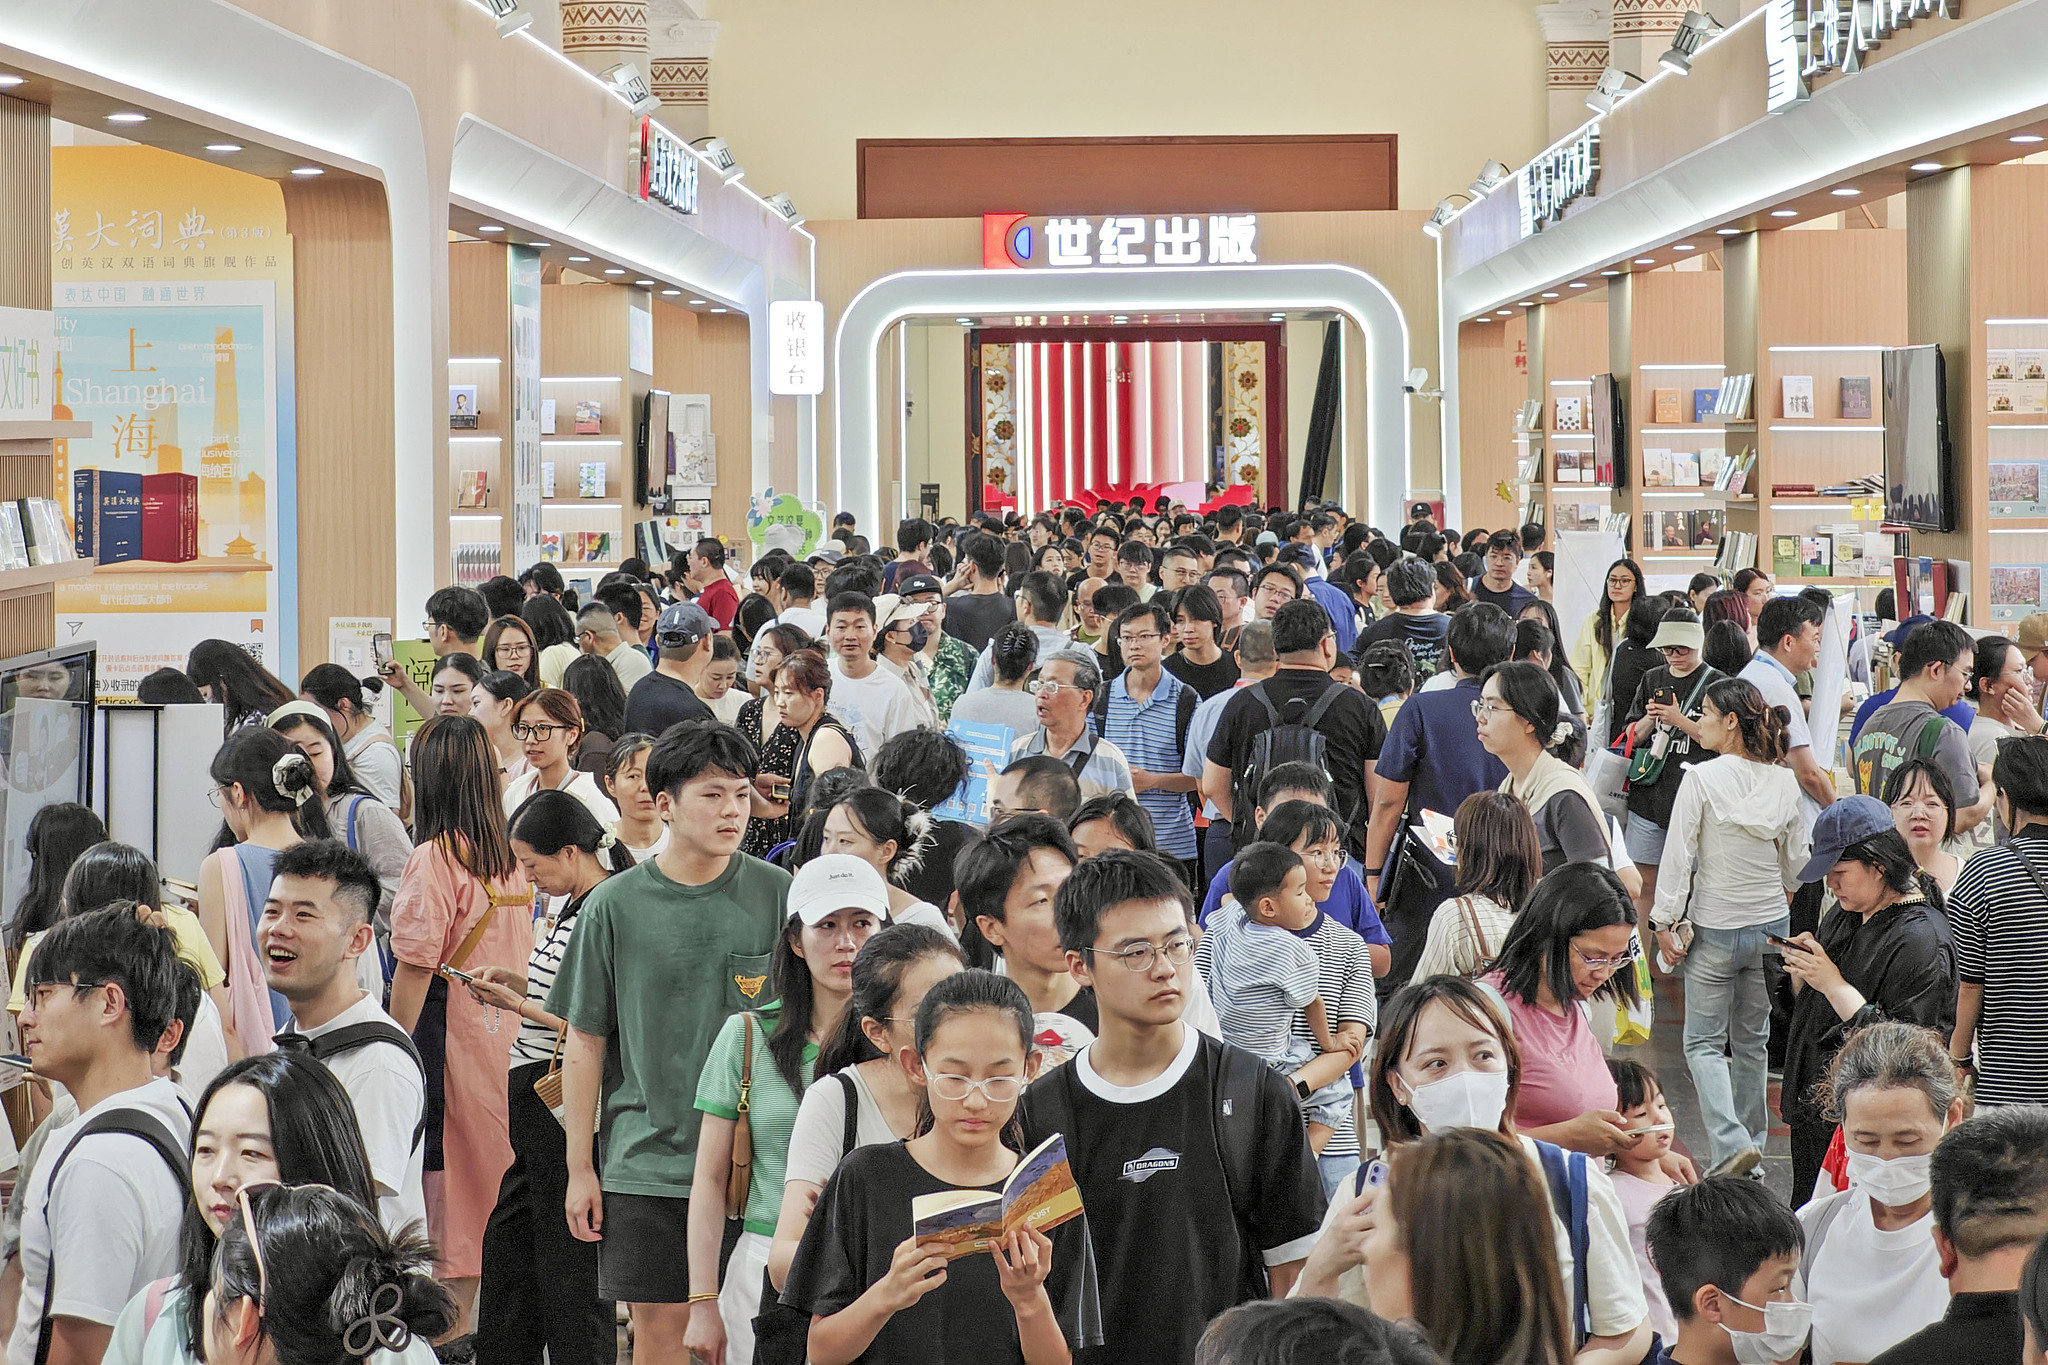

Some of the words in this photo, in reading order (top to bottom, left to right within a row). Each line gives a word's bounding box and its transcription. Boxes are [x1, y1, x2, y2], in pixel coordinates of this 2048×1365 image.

[1044, 213, 1258, 266] 世纪出版
[64, 287, 127, 303] 表达中国
[142, 286, 206, 302] 融通世界
[111, 327, 158, 372] 上
[786, 311, 806, 385] 收银台
[65, 377, 207, 410] Shanghai
[110, 413, 159, 460] 海
[200, 463, 245, 479] 海纳百川
[68, 582, 101, 591] modern
[1135, 1159, 1176, 1170] DRAGONS
